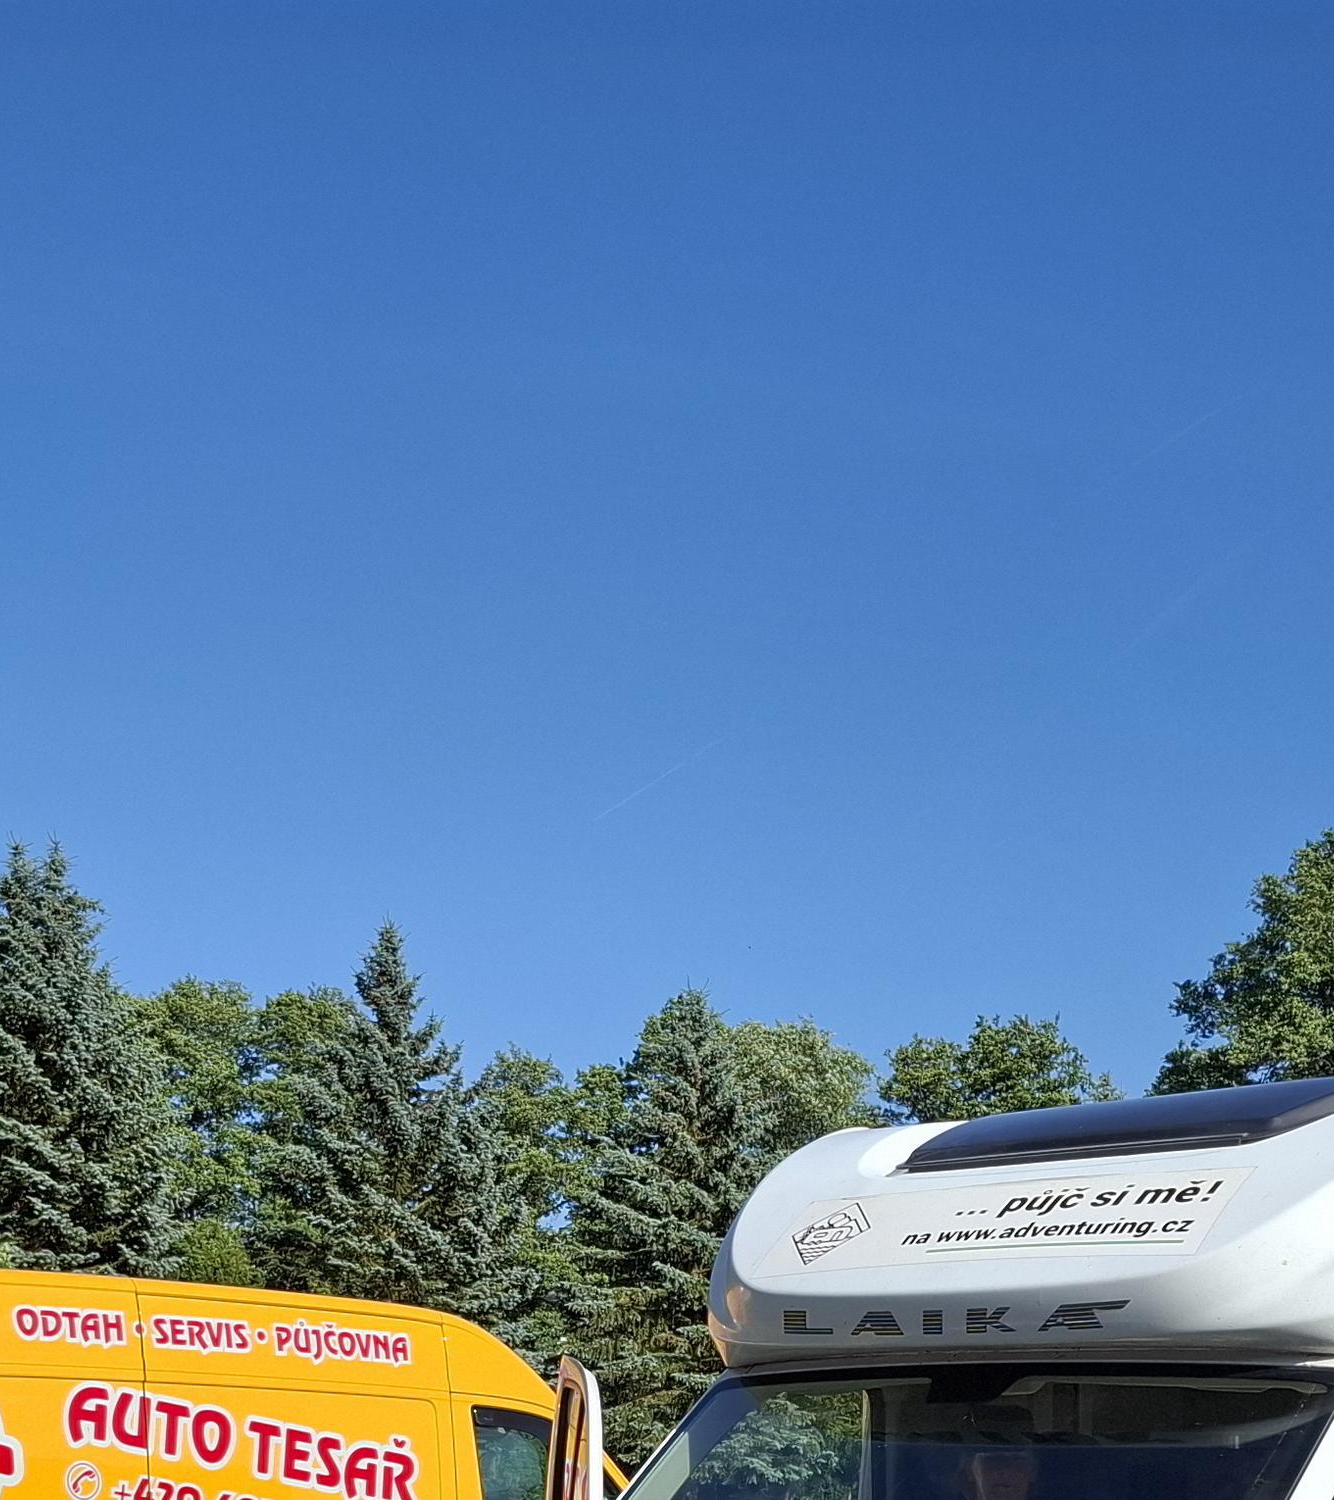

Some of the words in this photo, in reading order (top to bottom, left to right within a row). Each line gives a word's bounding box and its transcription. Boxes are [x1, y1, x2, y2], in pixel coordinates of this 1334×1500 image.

[995, 1186, 1091, 1218] půjč
[1090, 1184, 1135, 1207] si
[1134, 1179, 1224, 1205] mě!
[900, 1232, 932, 1246] na
[936, 1216, 1196, 1243] www.adventuring.cz
[14, 1307, 125, 1344] ODTAH
[152, 1316, 249, 1352] SERVIS
[274, 1319, 410, 1363] PŮJČOVNA
[782, 1299, 1132, 1337] LAIKA
[66, 1385, 234, 1466] AUTO
